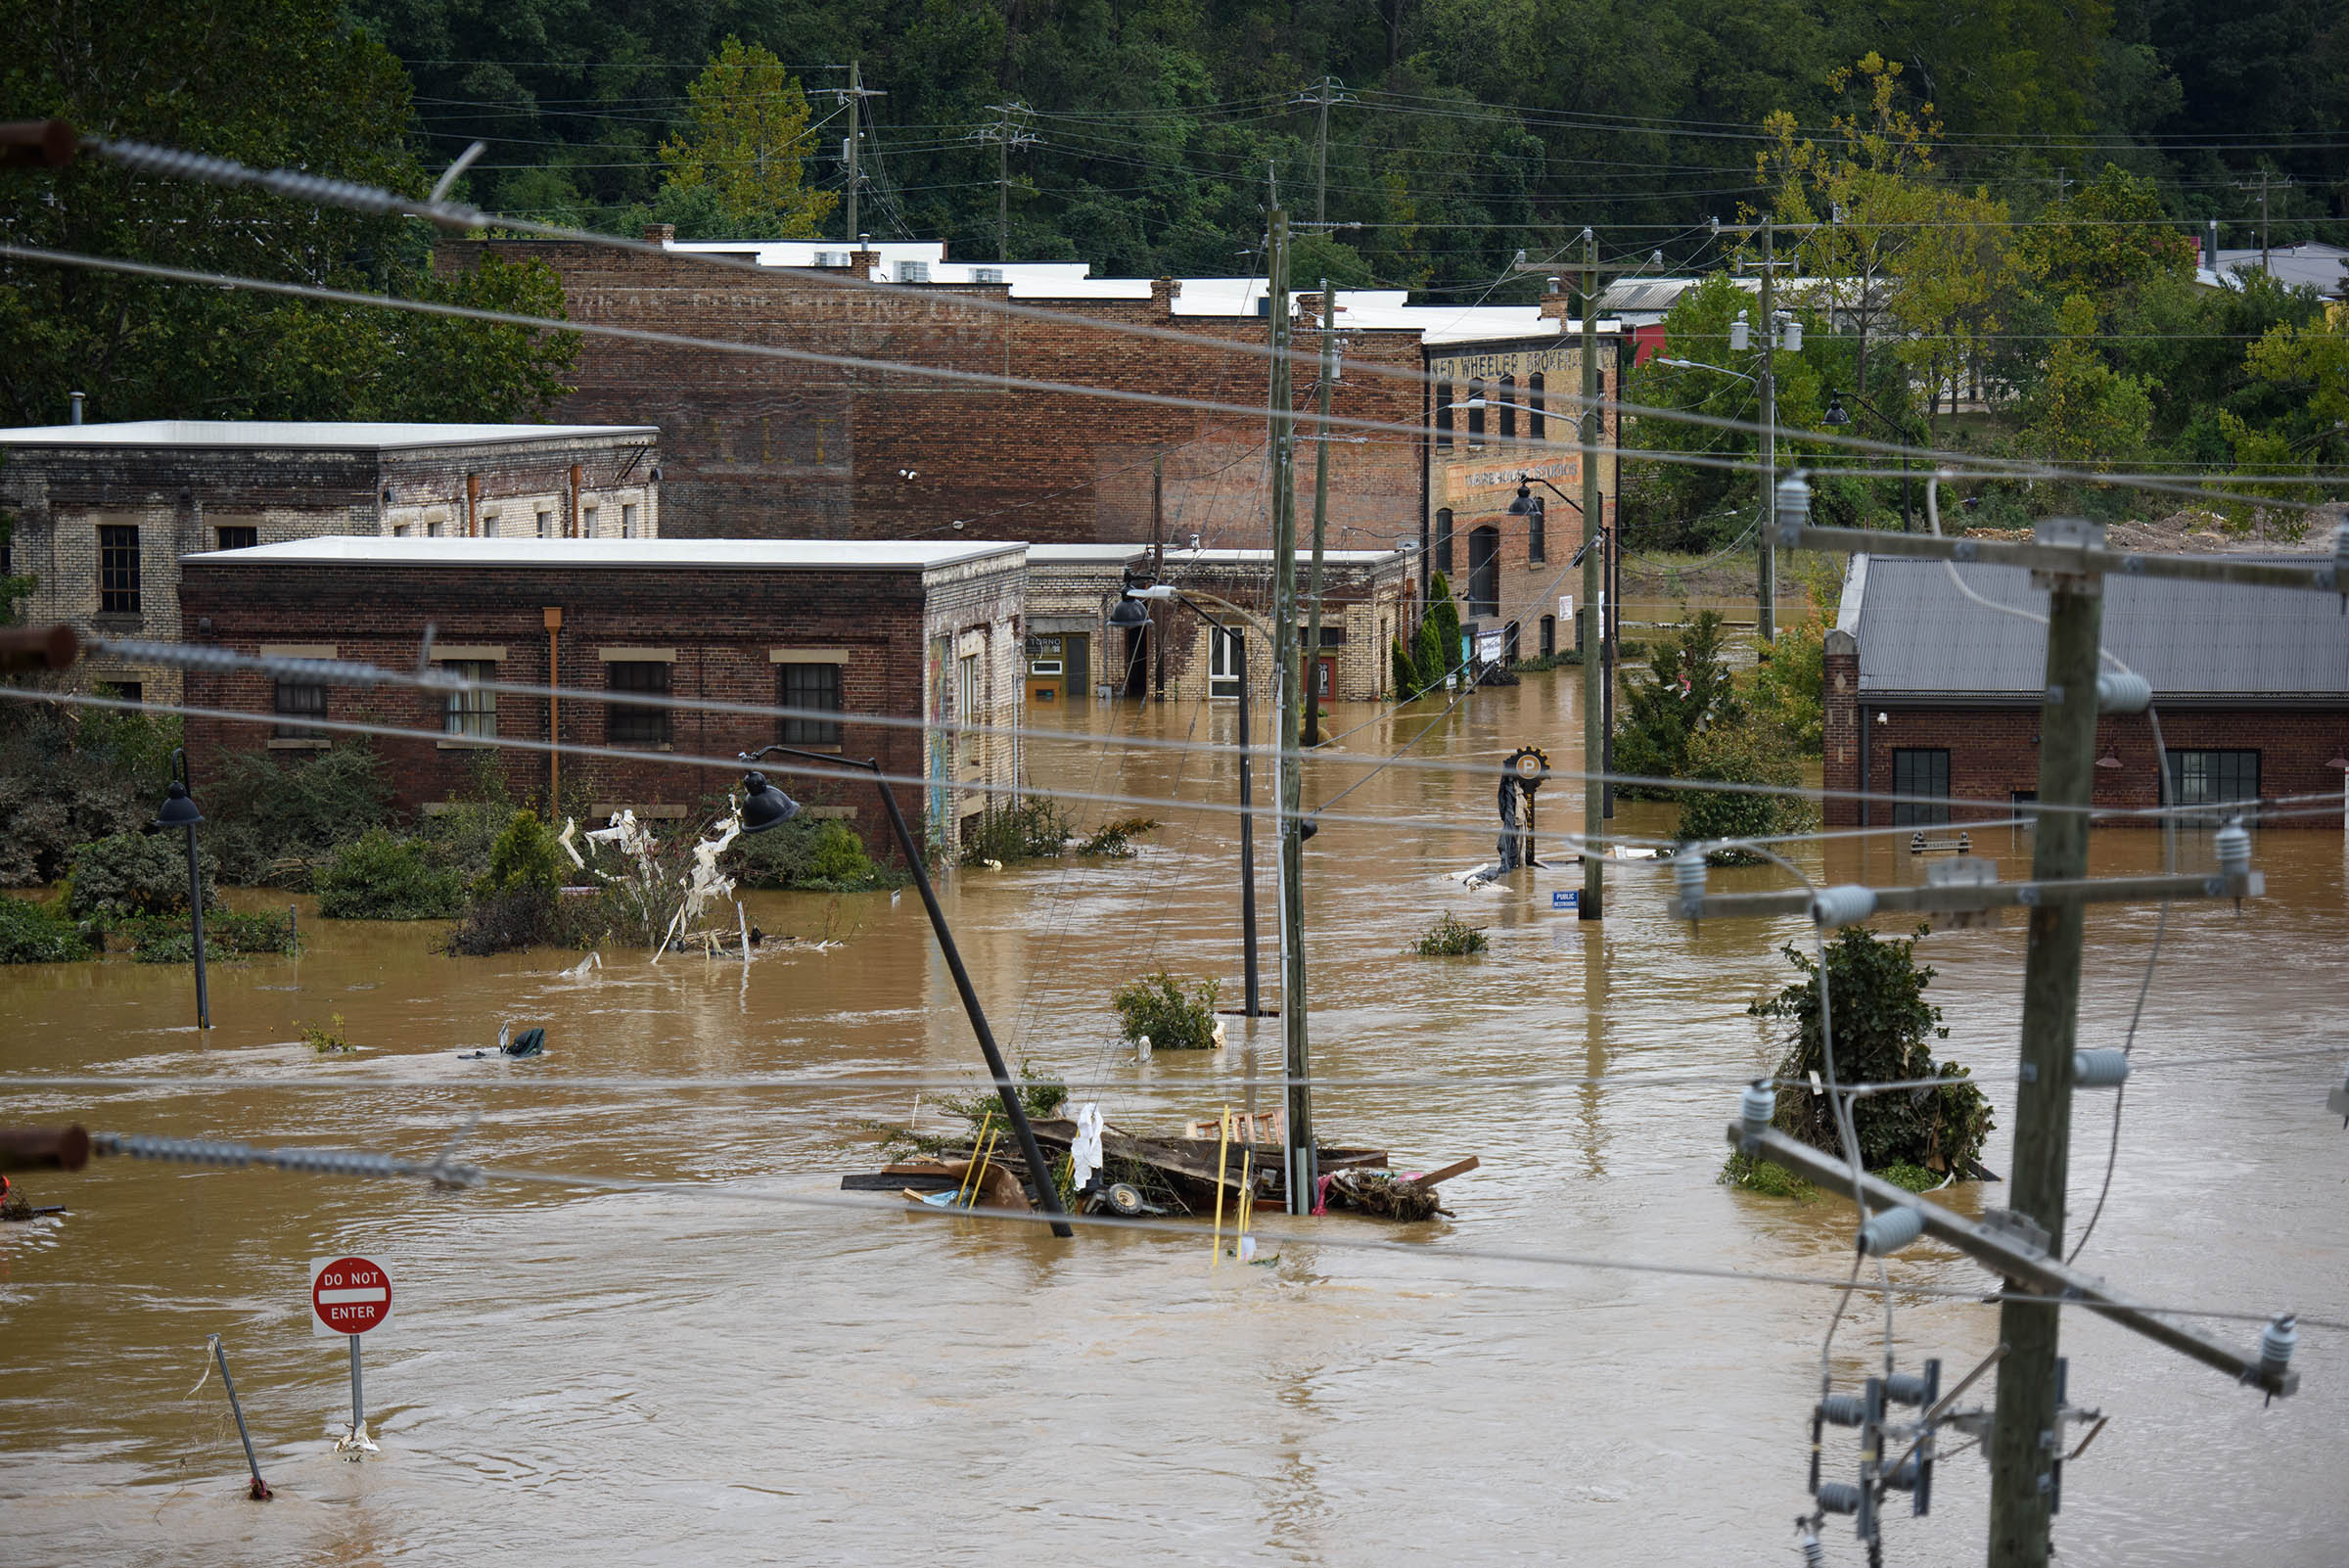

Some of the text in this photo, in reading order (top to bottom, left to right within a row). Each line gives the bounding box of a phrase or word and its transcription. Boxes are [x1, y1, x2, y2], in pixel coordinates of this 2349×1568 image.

[1461, 353, 1518, 378] WHEELER
[1535, 462, 1577, 479] STUDIOS
[1523, 761, 1536, 775] P
[324, 1272, 378, 1285] DO NOT
[331, 1307, 375, 1319] ENTER
